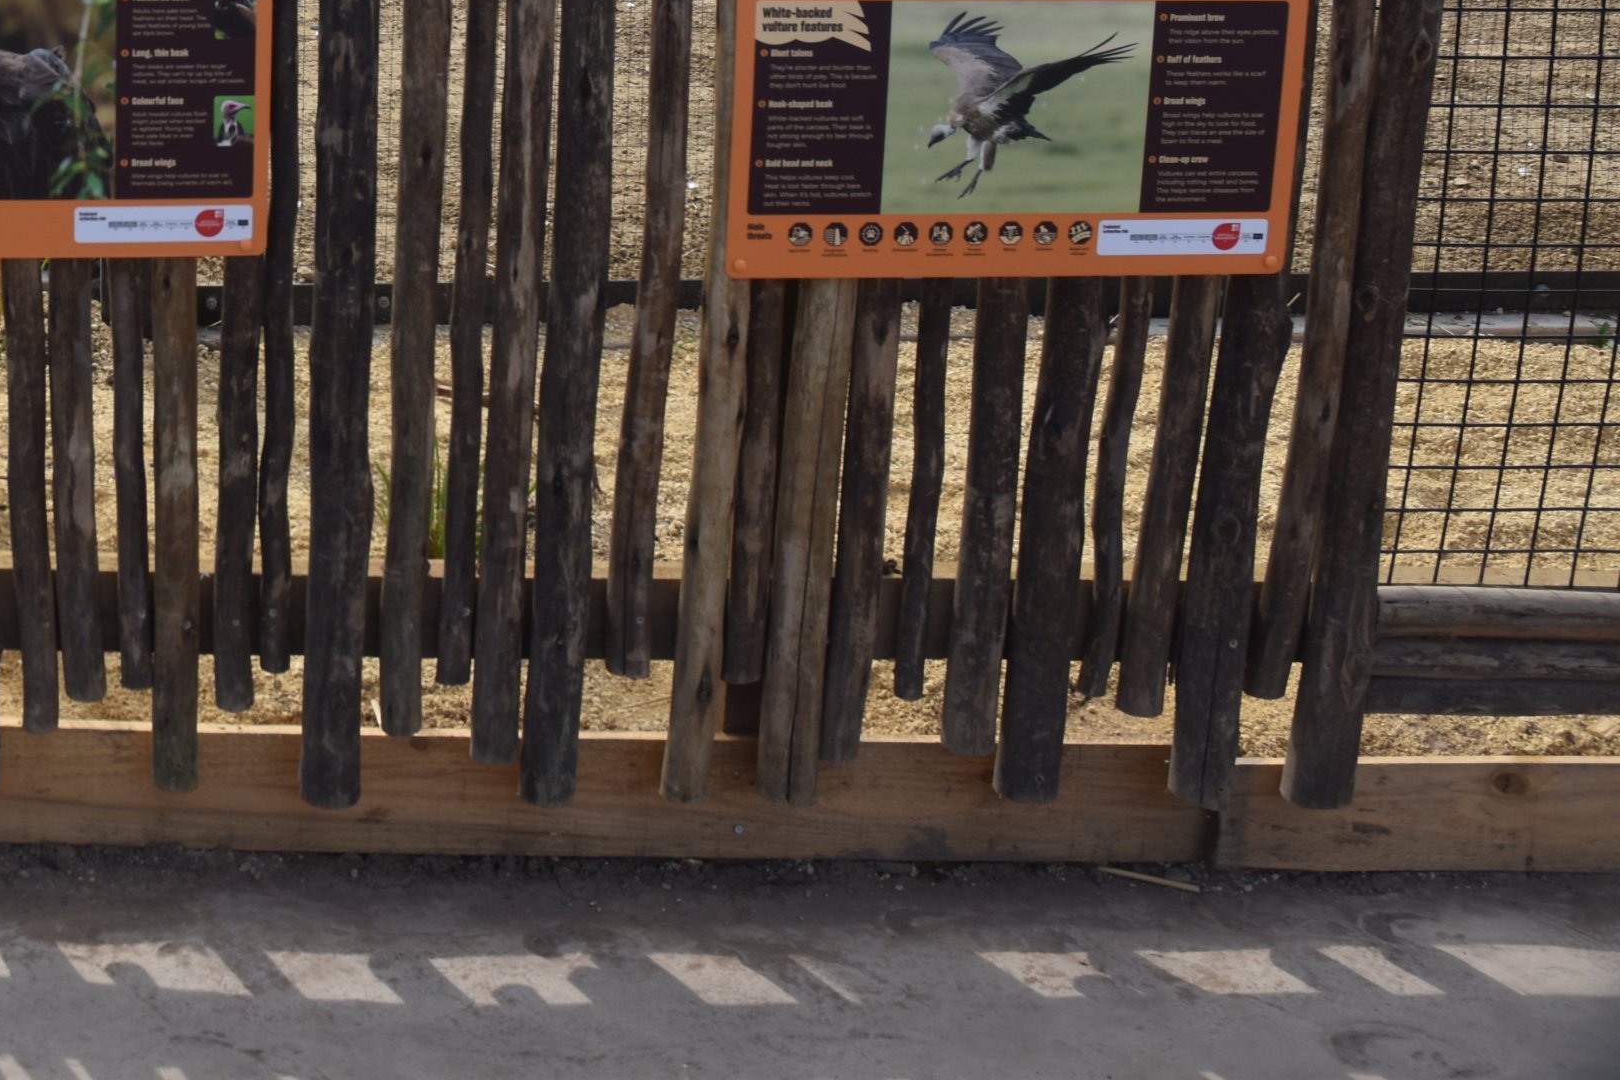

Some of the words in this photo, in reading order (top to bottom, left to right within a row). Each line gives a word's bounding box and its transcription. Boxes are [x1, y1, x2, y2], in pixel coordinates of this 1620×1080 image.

[762, 7, 833, 18] White-backed
[762, 21, 798, 33] vulture
[799, 21, 844, 33] features
[1184, 97, 1206, 106] wings
